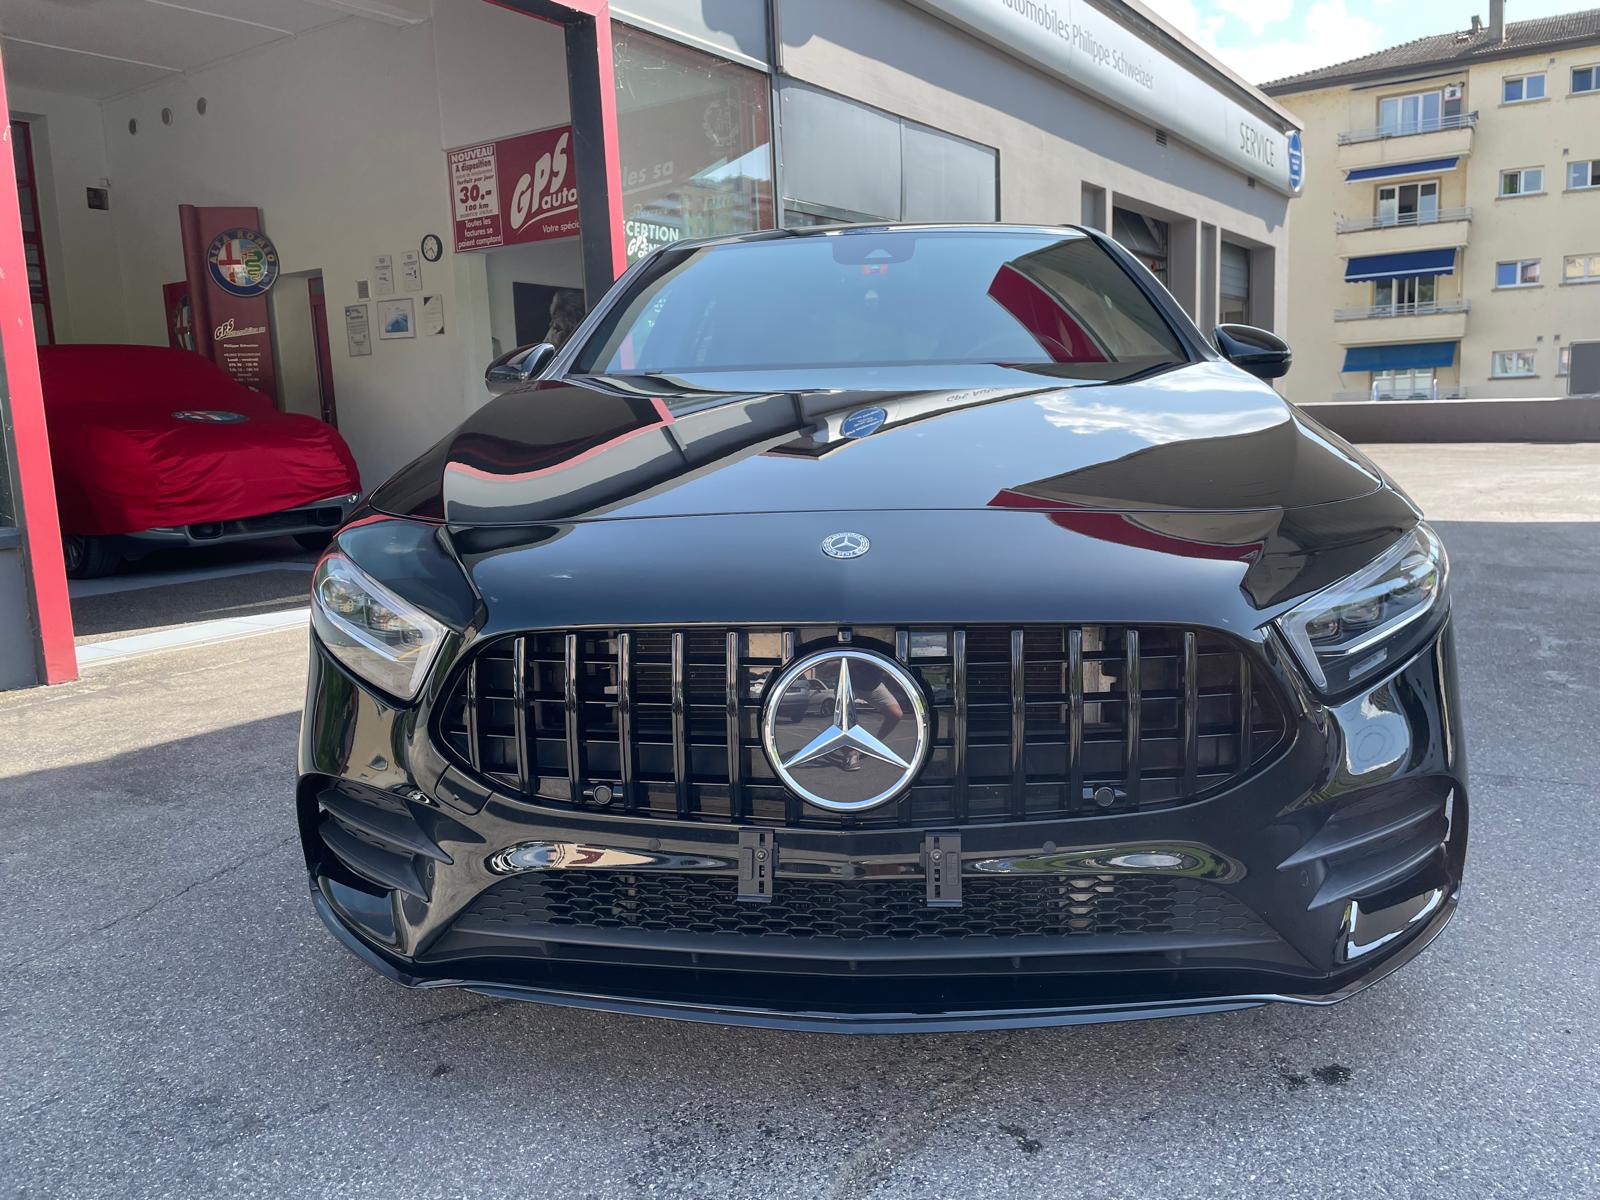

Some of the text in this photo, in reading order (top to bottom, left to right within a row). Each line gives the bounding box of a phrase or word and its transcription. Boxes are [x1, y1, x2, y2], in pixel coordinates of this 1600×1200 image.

[1002, 0, 1154, 90] utomobiles Philippe Schweizer
[1240, 122, 1274, 168] SERVICE
[451, 146, 493, 163] NOUVEAU
[461, 159, 492, 172] disposition
[510, 132, 569, 229] GPS
[459, 184, 492, 203] 30.-
[465, 204, 477, 212] 100
[465, 217, 491, 228] Toutes les
[542, 223, 559, 233] Votre
[465, 228, 486, 238] factures
[209, 230, 276, 264] ALFA ROMEO
[458, 234, 502, 250] paient comptant
[214, 318, 235, 340] GPS
